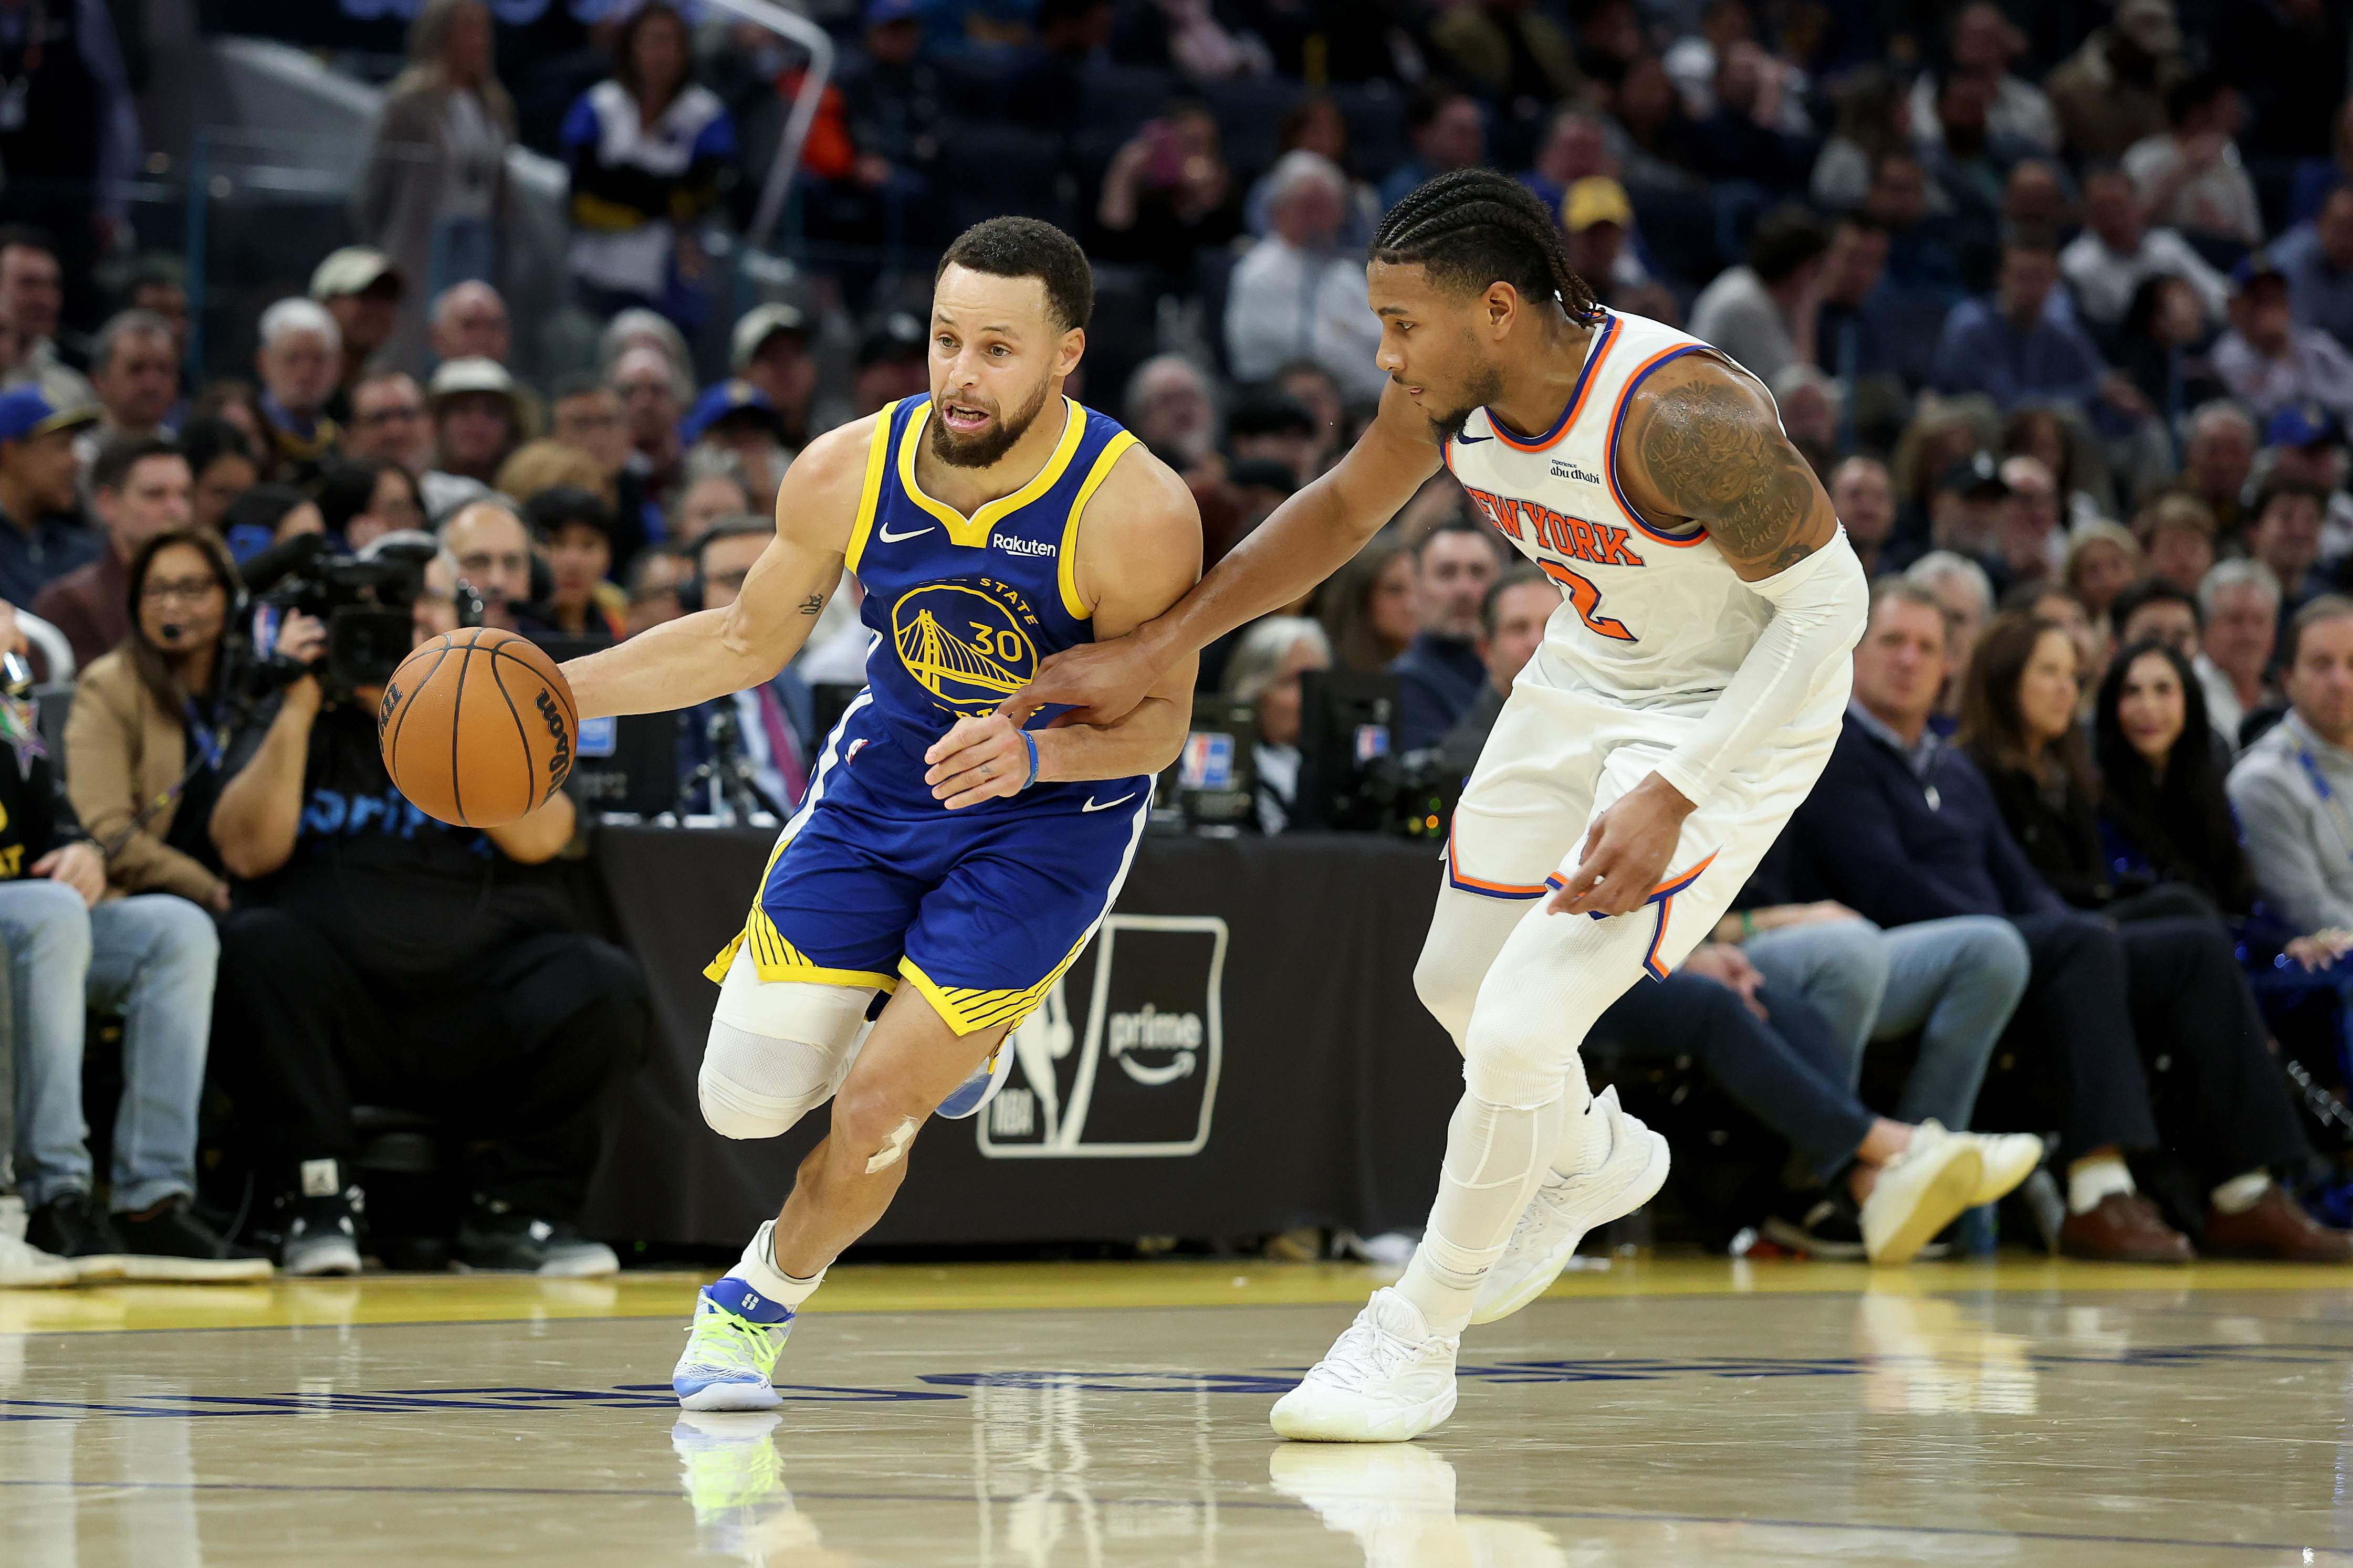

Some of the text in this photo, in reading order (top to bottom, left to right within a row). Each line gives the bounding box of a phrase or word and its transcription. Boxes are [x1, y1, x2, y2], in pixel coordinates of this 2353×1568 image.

[1550, 466, 1601, 484] abu dhabi
[1551, 459, 1577, 468] experience
[993, 533, 1057, 557] Rakuten
[1462, 485, 1647, 567] EW YORK
[979, 577, 1039, 626] STATE
[1536, 556, 1638, 642] 2
[969, 622, 1022, 662] 30
[1108, 1002, 1204, 1058] prime
